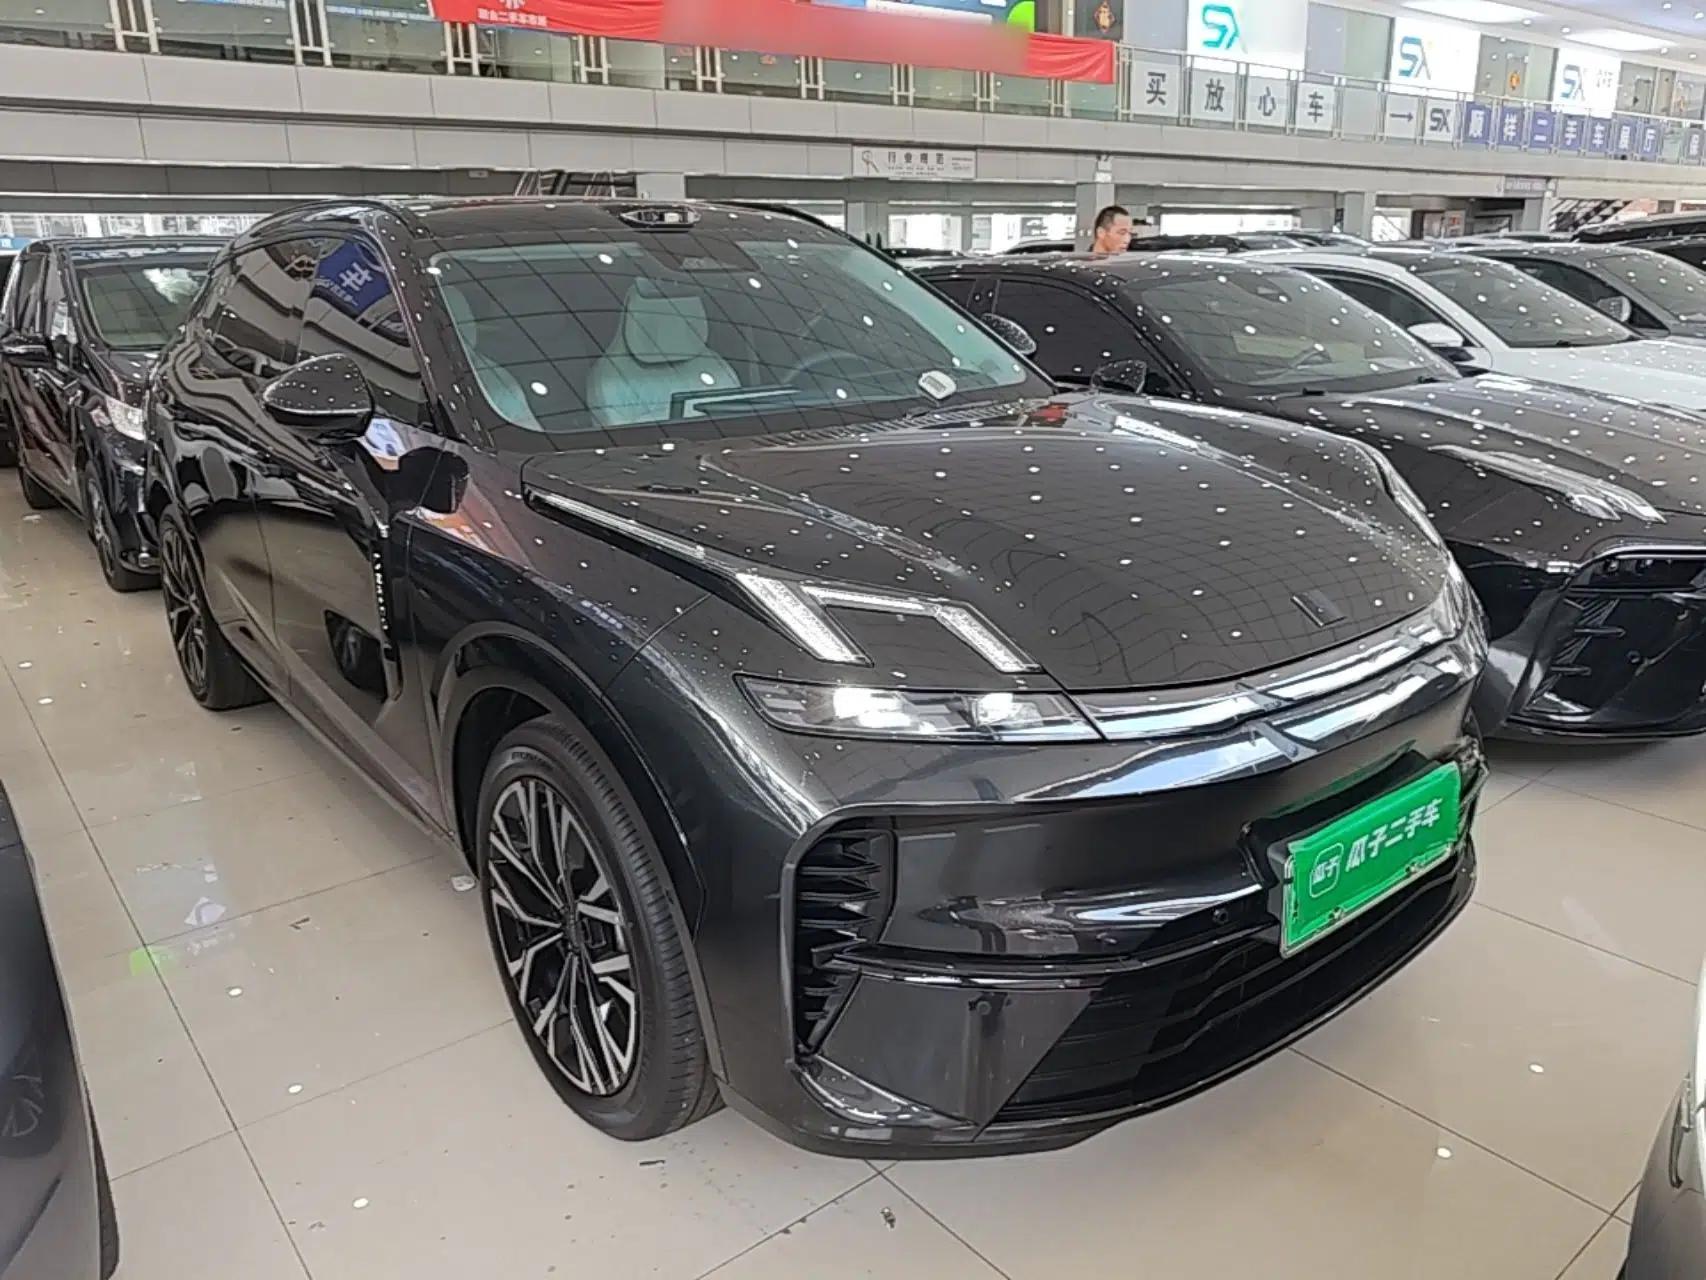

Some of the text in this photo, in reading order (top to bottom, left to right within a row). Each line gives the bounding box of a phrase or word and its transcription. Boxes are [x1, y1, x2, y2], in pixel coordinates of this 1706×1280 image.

[1345, 797, 1443, 873] 瓜子二手车
[1311, 855, 1341, 885] 瓜子
